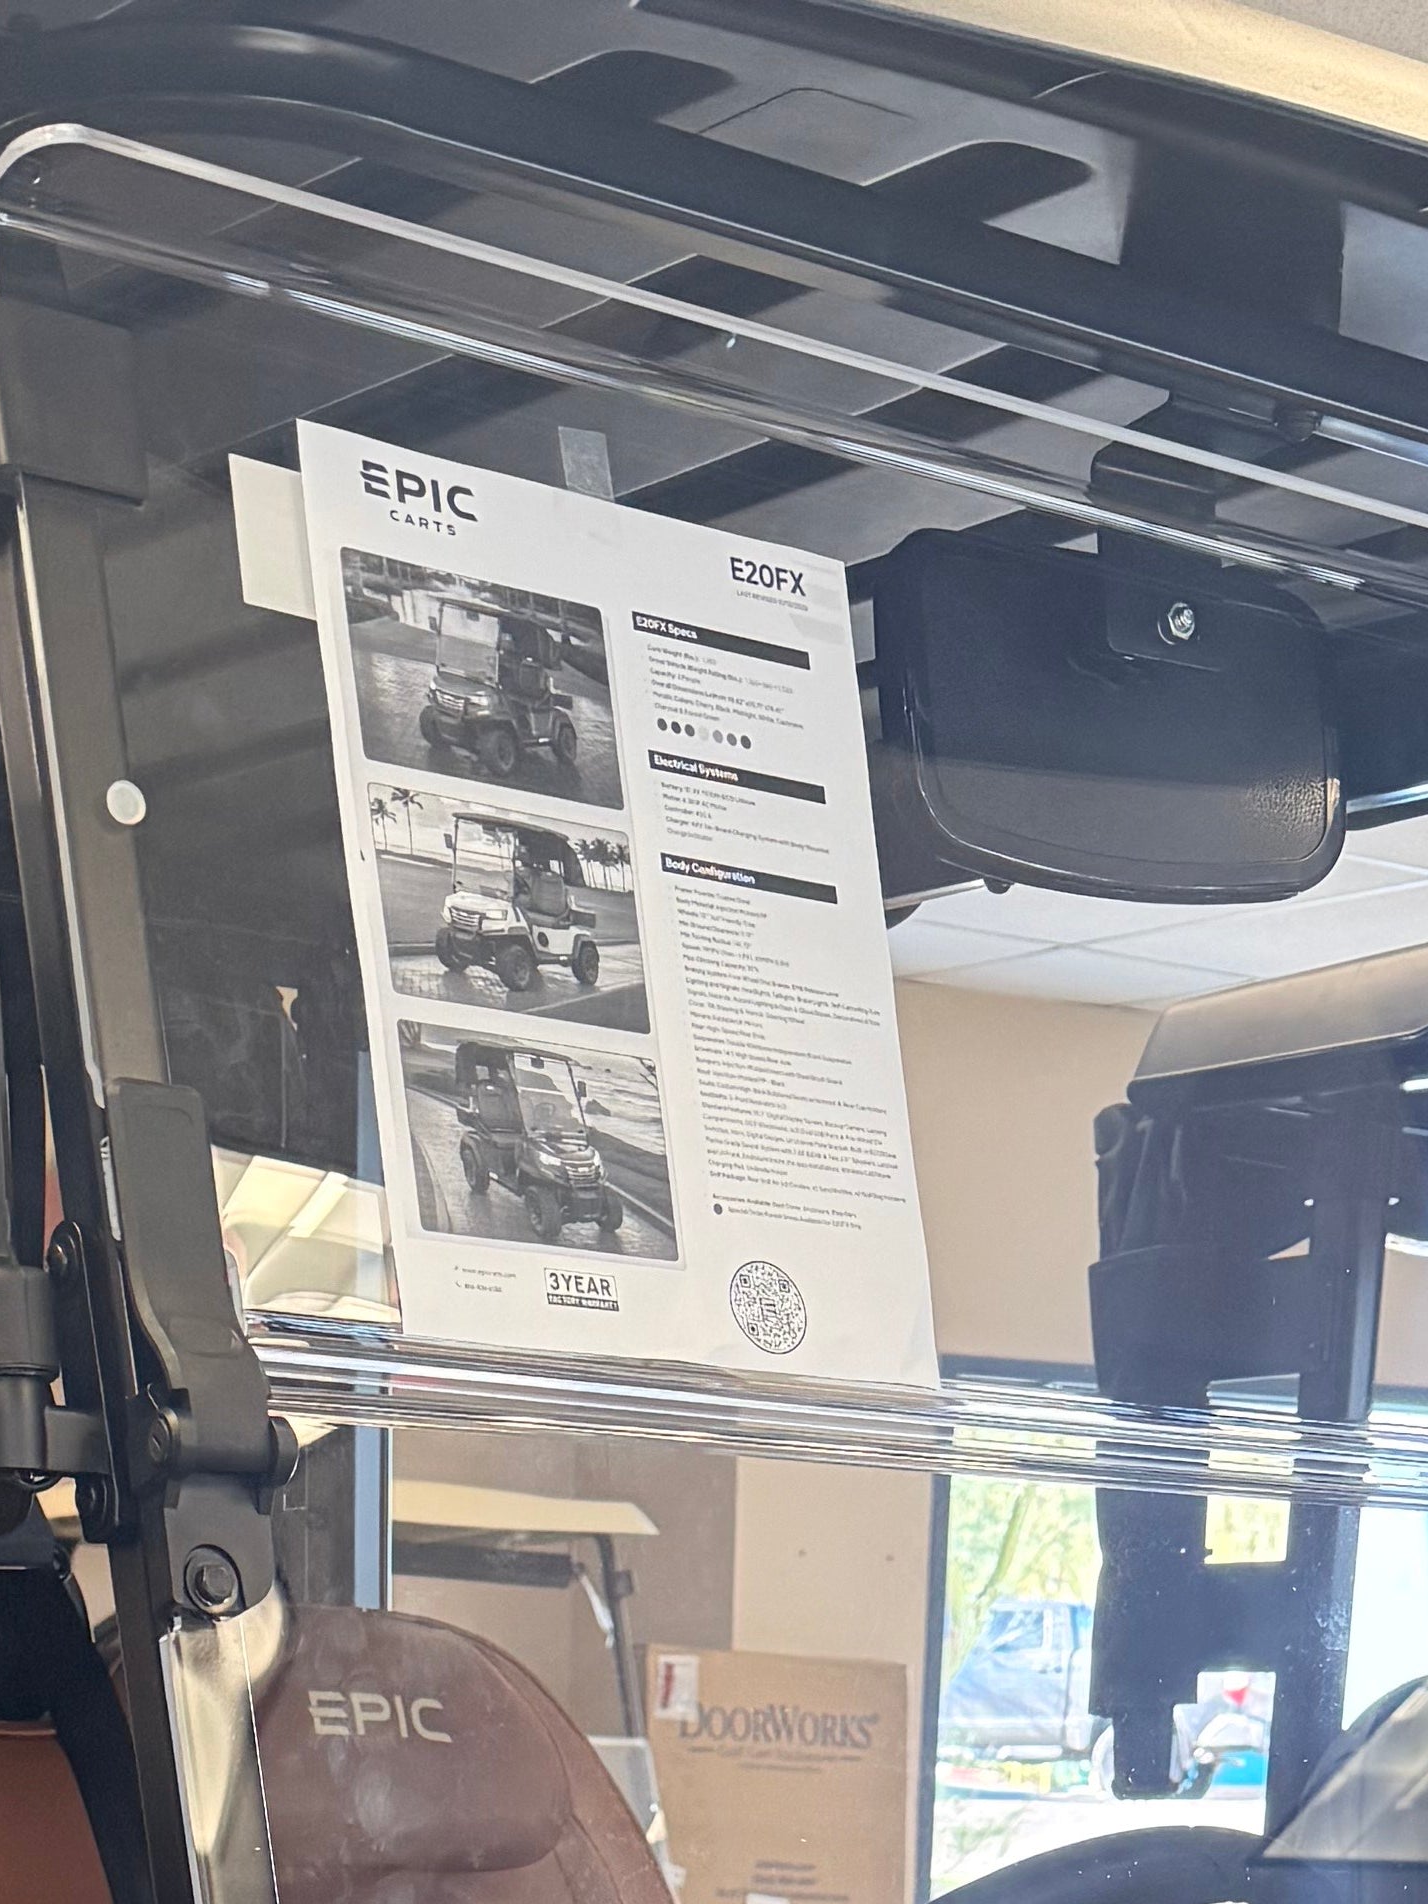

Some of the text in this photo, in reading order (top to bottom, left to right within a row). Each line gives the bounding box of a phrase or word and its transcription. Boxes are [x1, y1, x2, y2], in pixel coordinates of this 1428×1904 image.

[359, 459, 478, 523] EPIC
[389, 508, 458, 536] CARTS
[730, 557, 806, 597] E20FX
[636, 616, 698, 639] E20FX Specs
[654, 755, 739, 782] Electrical Systems
[666, 857, 756, 885] Body Configuration
[307, 1690, 452, 1744] EPIC
